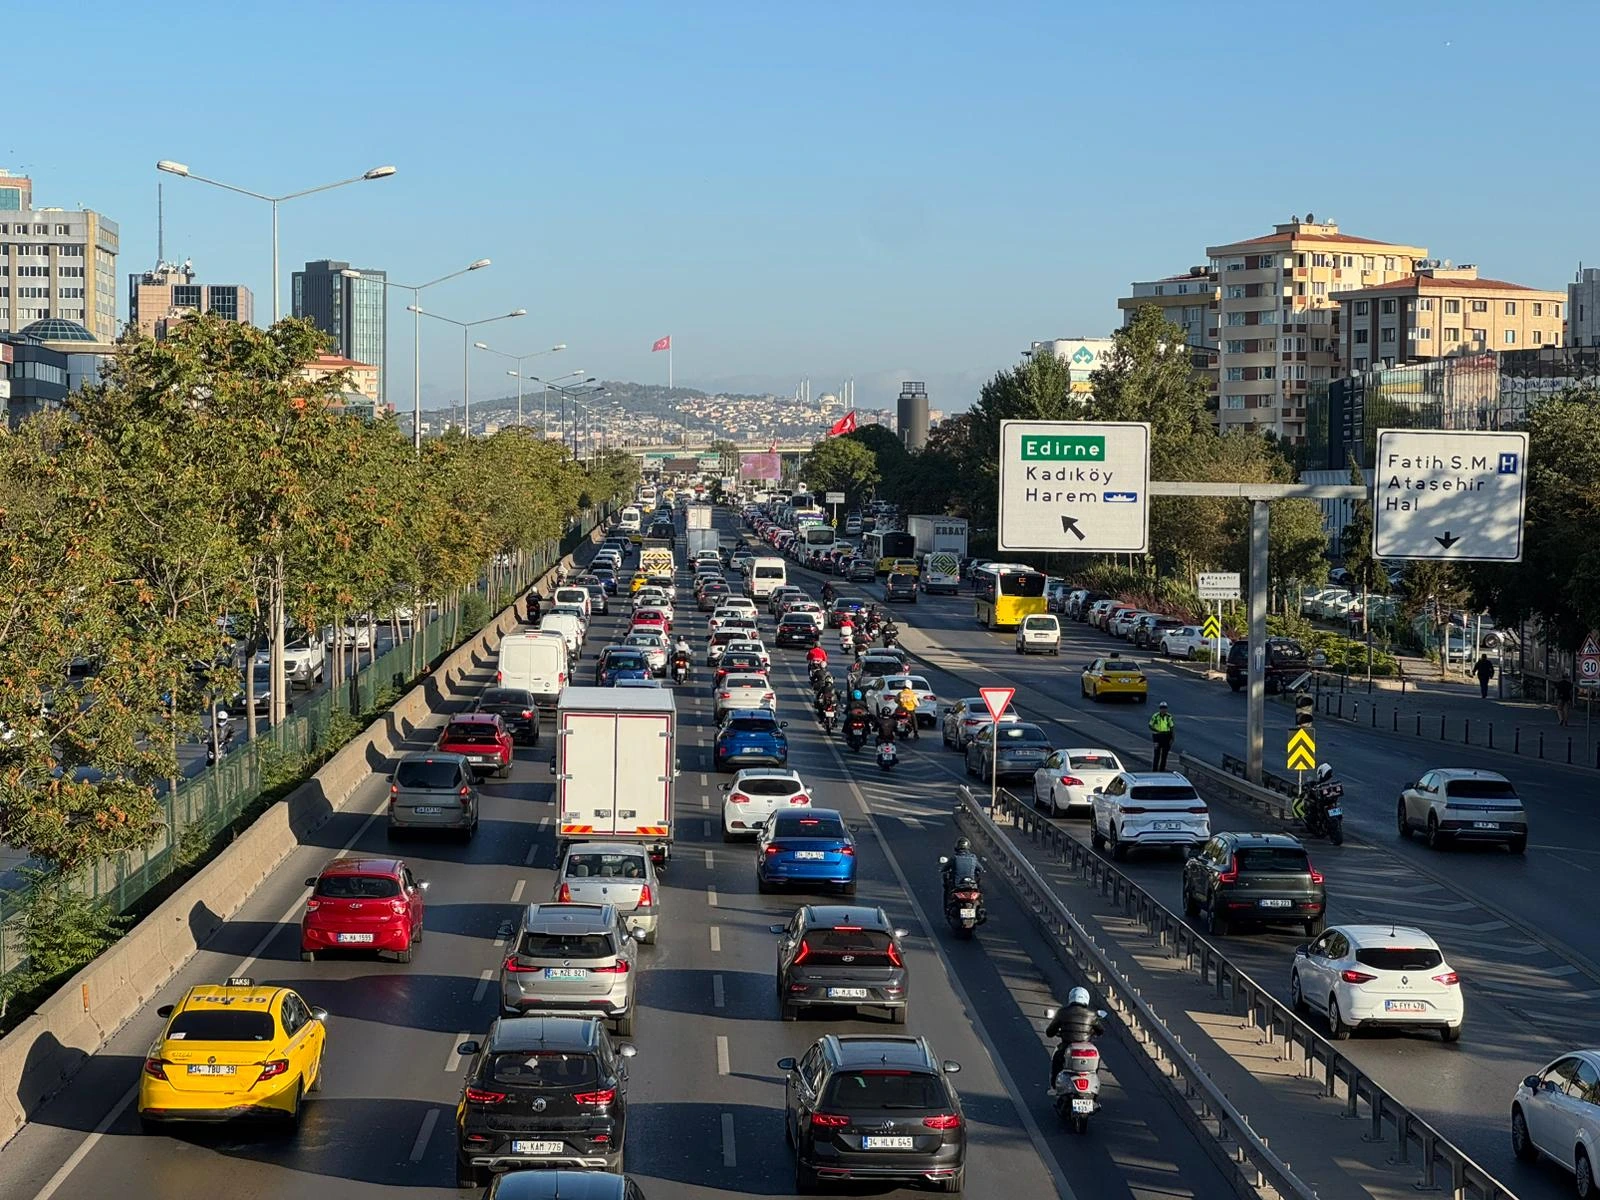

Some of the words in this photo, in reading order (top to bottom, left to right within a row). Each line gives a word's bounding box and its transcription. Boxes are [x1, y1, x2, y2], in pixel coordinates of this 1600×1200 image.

[1026, 441, 1100, 456] Edirne
[1388, 454, 1443, 469] Fatih
[1451, 455, 1494, 471] S.M.
[1501, 456, 1515, 471] H
[1026, 466, 1113, 485] Kadıköy
[1388, 475, 1485, 491] Ataşehir
[1026, 488, 1097, 502] Harem
[1386, 497, 1418, 511] Hal
[1584, 661, 1597, 672] 30
[193, 1064, 201, 1073] 34
[518, 1142, 526, 1151] 34
[530, 1142, 544, 1151] KAM
[868, 1137, 877, 1147] 34
